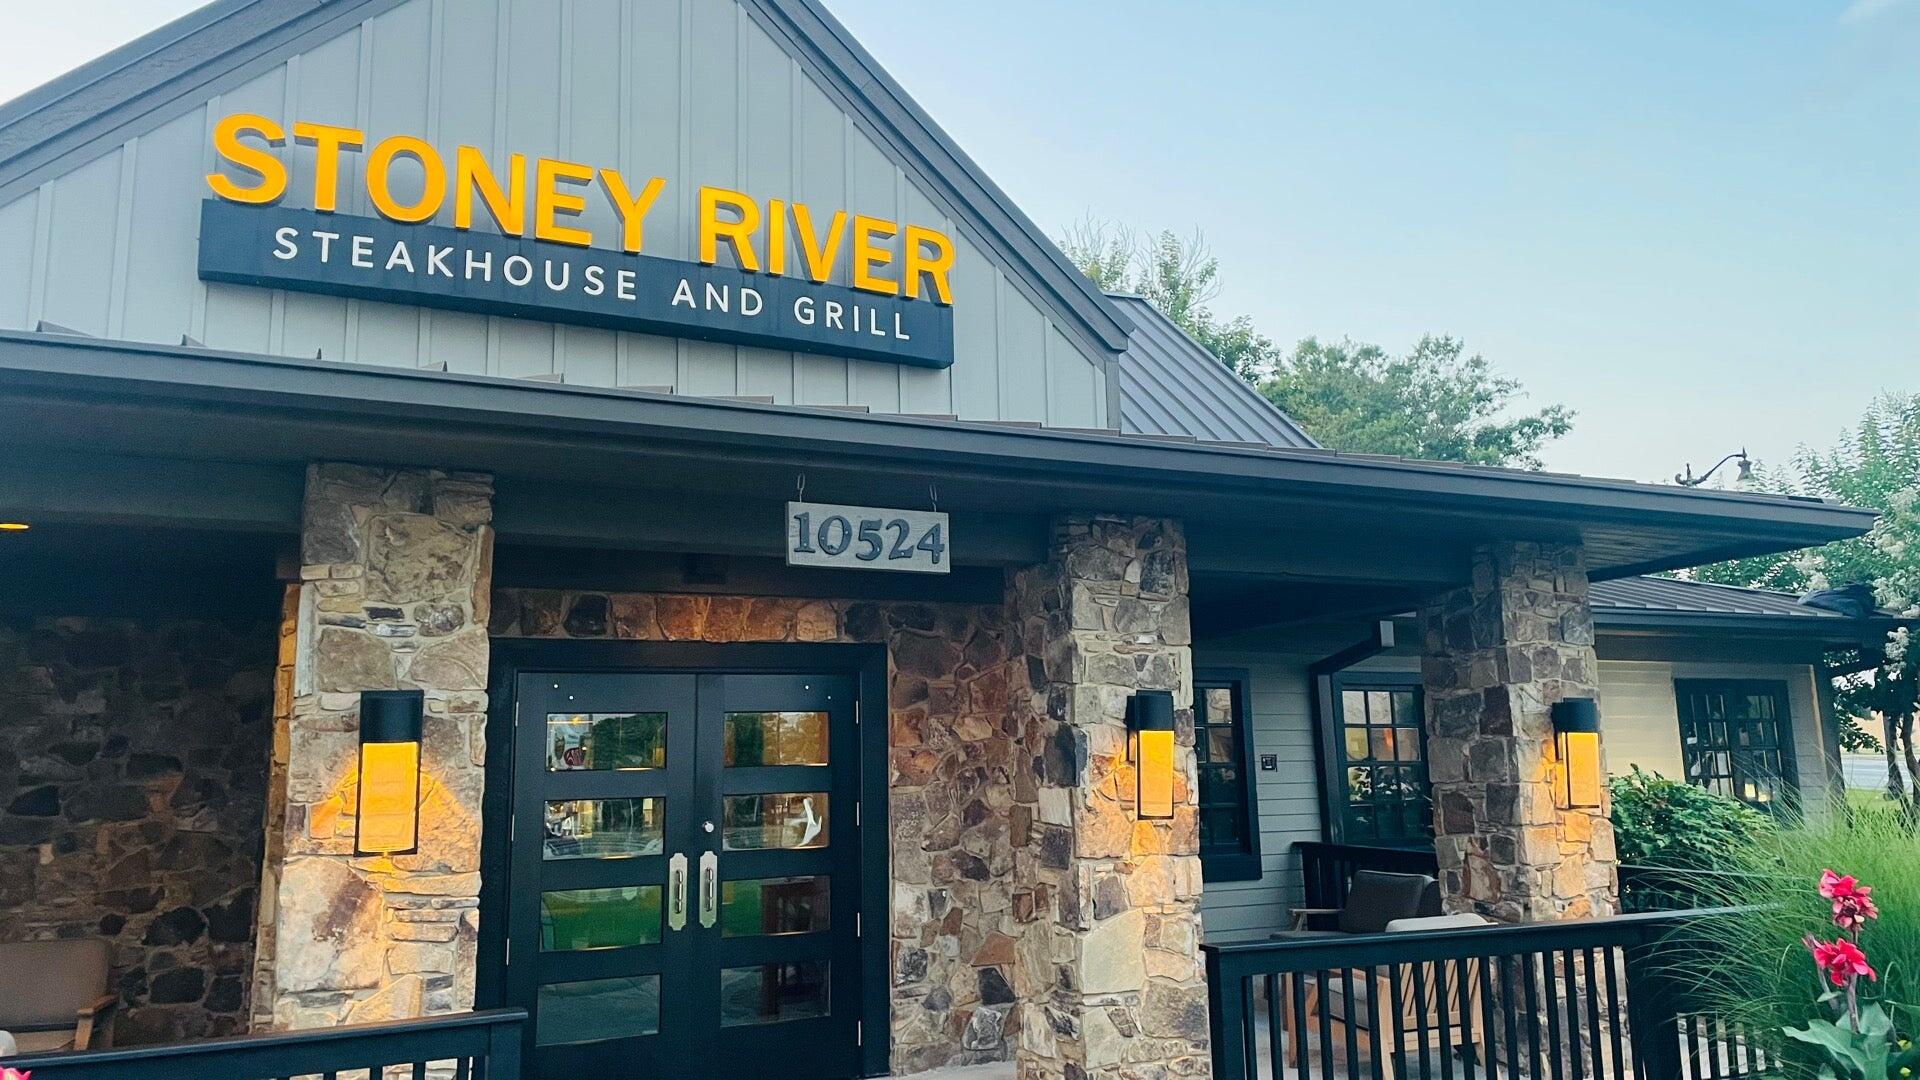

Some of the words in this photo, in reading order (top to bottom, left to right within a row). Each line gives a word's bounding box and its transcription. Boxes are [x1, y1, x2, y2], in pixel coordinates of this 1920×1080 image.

[206, 113, 666, 253] STONEY
[699, 186, 956, 306] RIVER
[272, 227, 637, 300] STEAKHOUSE
[671, 278, 764, 317] AND
[794, 296, 911, 341] GRILL
[793, 511, 946, 565] 10524
